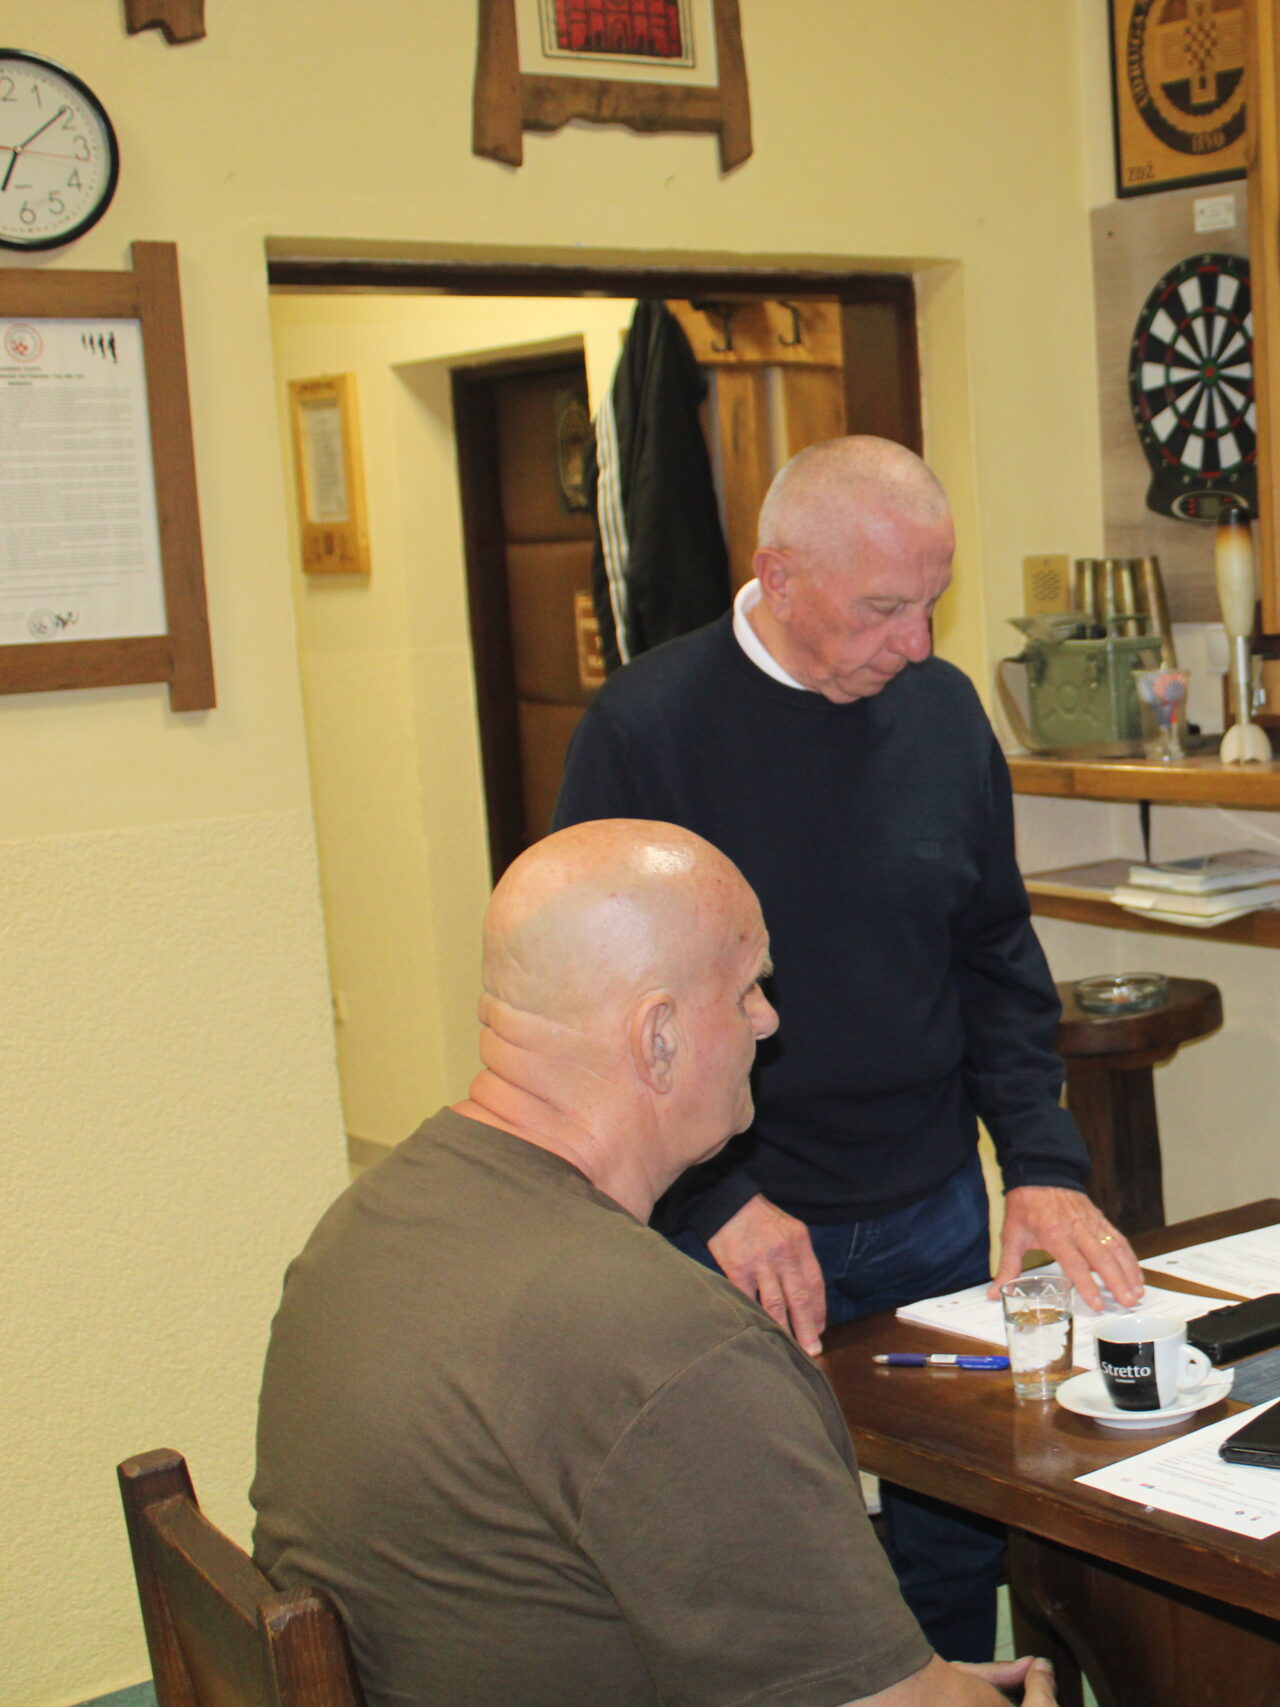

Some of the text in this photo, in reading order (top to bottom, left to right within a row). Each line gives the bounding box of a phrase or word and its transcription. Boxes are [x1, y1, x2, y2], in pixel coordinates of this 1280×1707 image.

[31, 84, 42, 109] 1
[73, 136, 90, 162] 3
[67, 168, 82, 191] 4
[19, 201, 36, 225] 6
[49, 191, 65, 215] 5
[1101, 1361, 1152, 1379] Stretto
